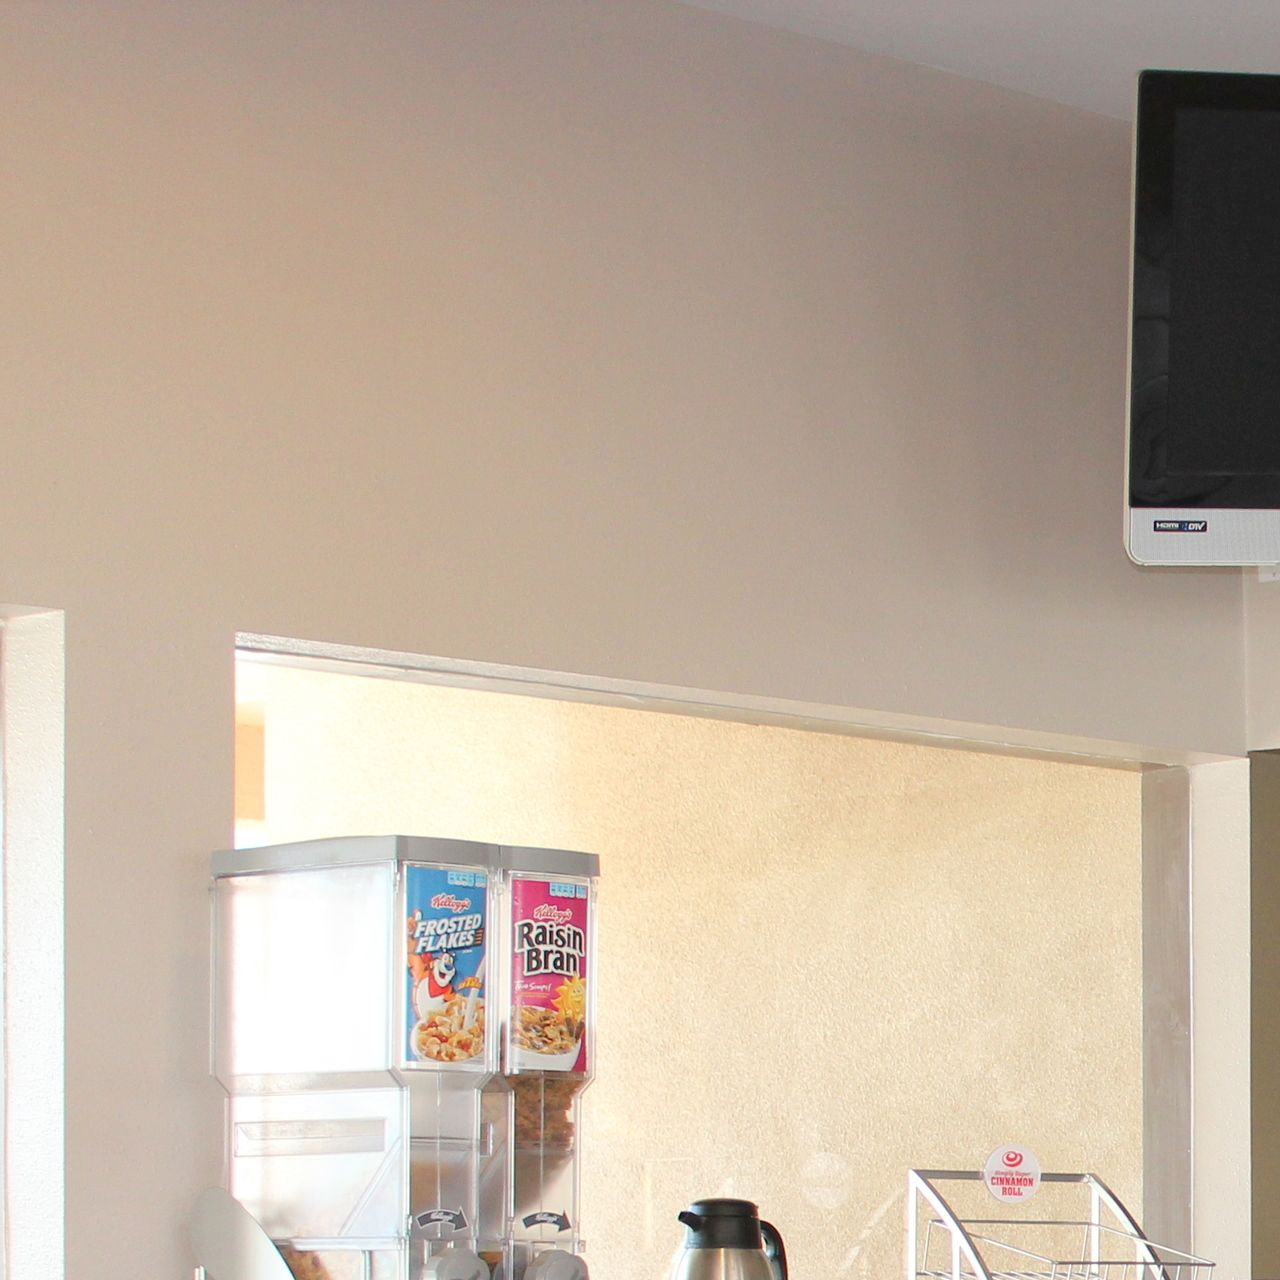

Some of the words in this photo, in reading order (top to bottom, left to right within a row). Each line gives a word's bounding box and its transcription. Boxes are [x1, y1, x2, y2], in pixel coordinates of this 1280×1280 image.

[414, 914, 482, 938] FROSTED
[516, 920, 585, 955] Raisin
[416, 930, 476, 954] FLAKES
[525, 947, 579, 976] Bran
[991, 1176, 1034, 1187] CINNAMON
[1002, 1187, 1023, 1196] ROLL
